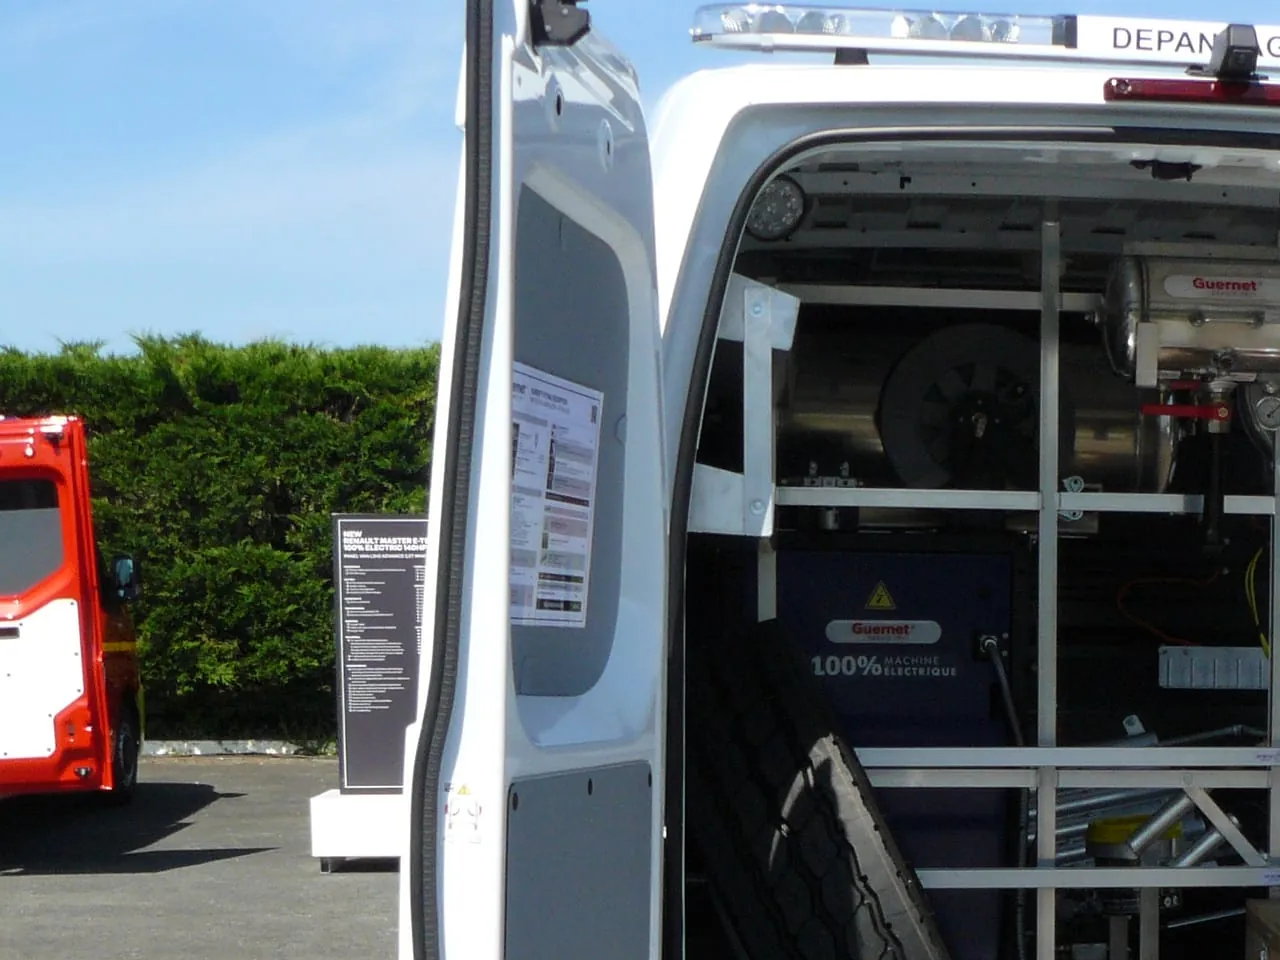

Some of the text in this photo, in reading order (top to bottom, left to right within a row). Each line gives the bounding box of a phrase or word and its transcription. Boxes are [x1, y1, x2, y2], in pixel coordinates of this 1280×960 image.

[1192, 277, 1257, 291] Guernet
[852, 622, 910, 635] Guernet
[811, 655, 940, 676] 100% MACHINE
